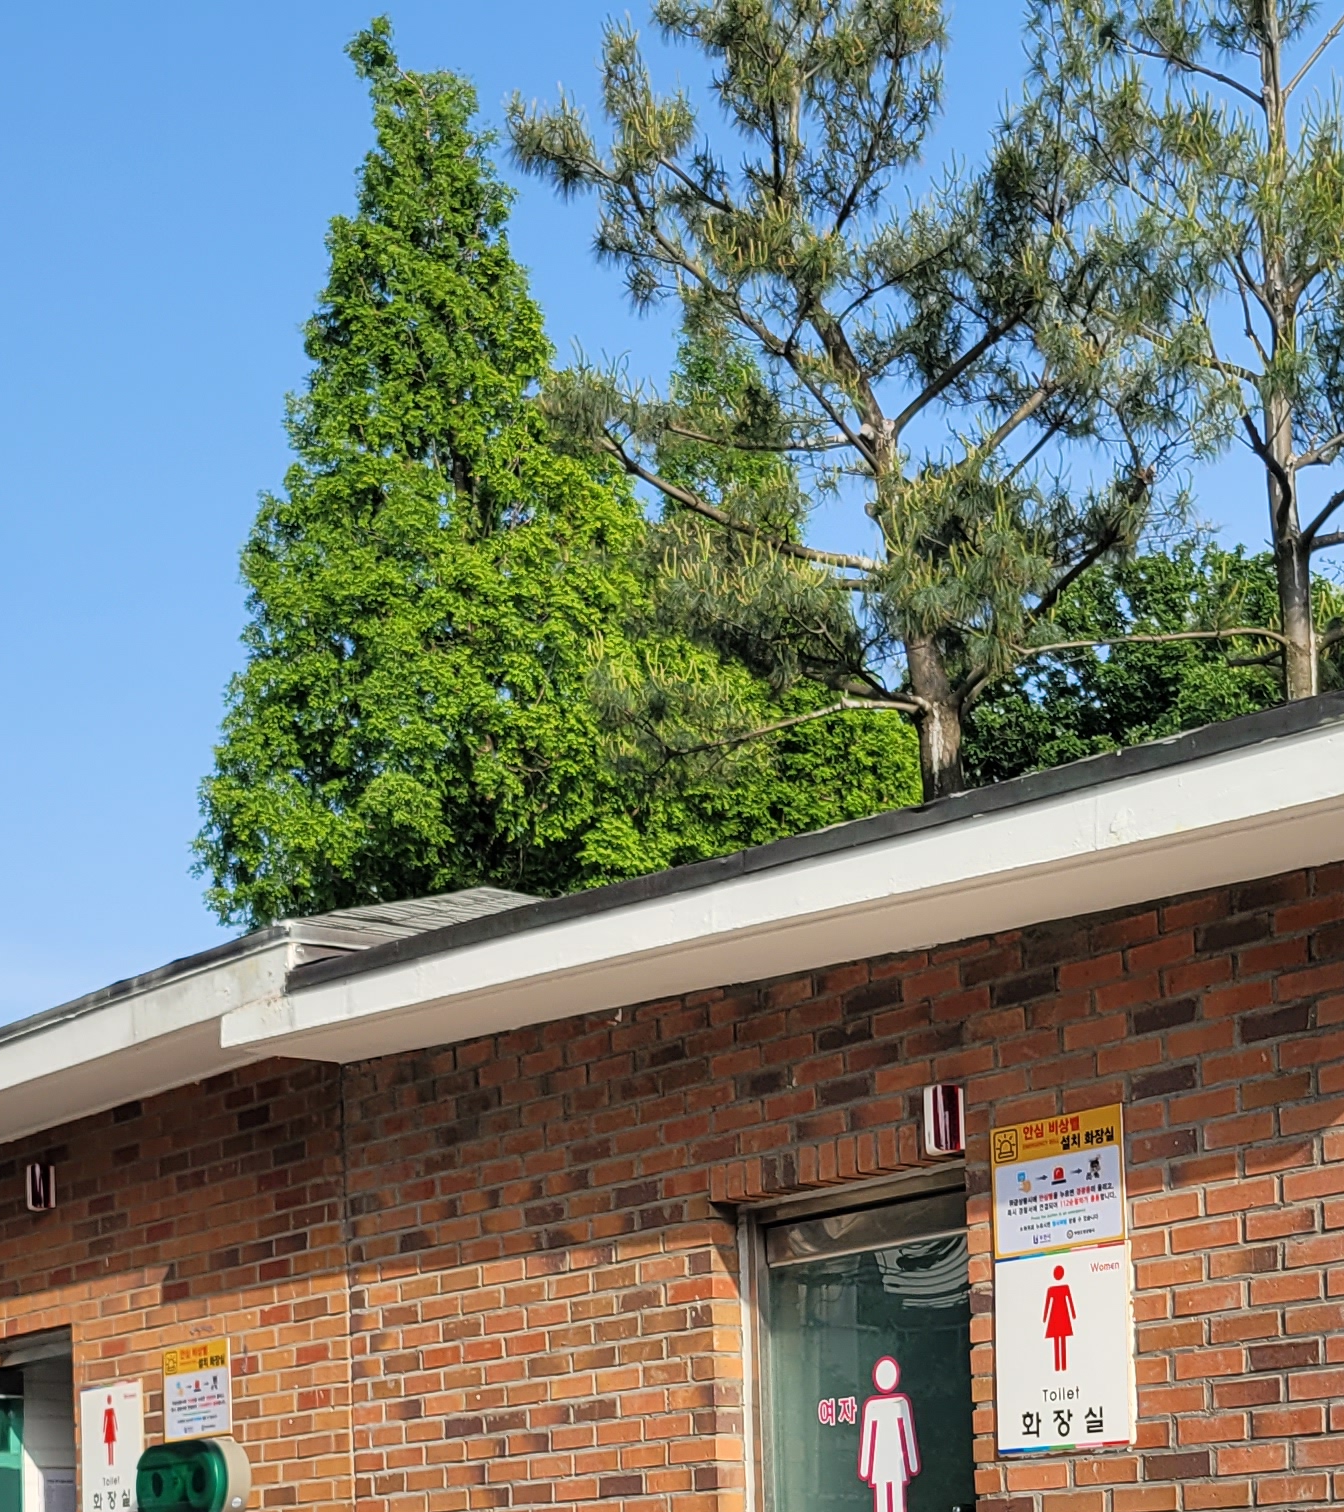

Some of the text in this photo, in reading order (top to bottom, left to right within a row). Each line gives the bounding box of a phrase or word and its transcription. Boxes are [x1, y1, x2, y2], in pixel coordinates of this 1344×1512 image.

[1022, 1115, 1080, 1140] 안심 비상벨
[1060, 1126, 1115, 1151] 설치 화장실
[1090, 1260, 1121, 1273] Women
[1042, 1385, 1081, 1403] Toilet
[818, 1396, 858, 1425] 여자
[1021, 1406, 1105, 1439] 화장실
[102, 1475, 121, 1487] Toilet
[93, 1488, 131, 1511] 화장실
